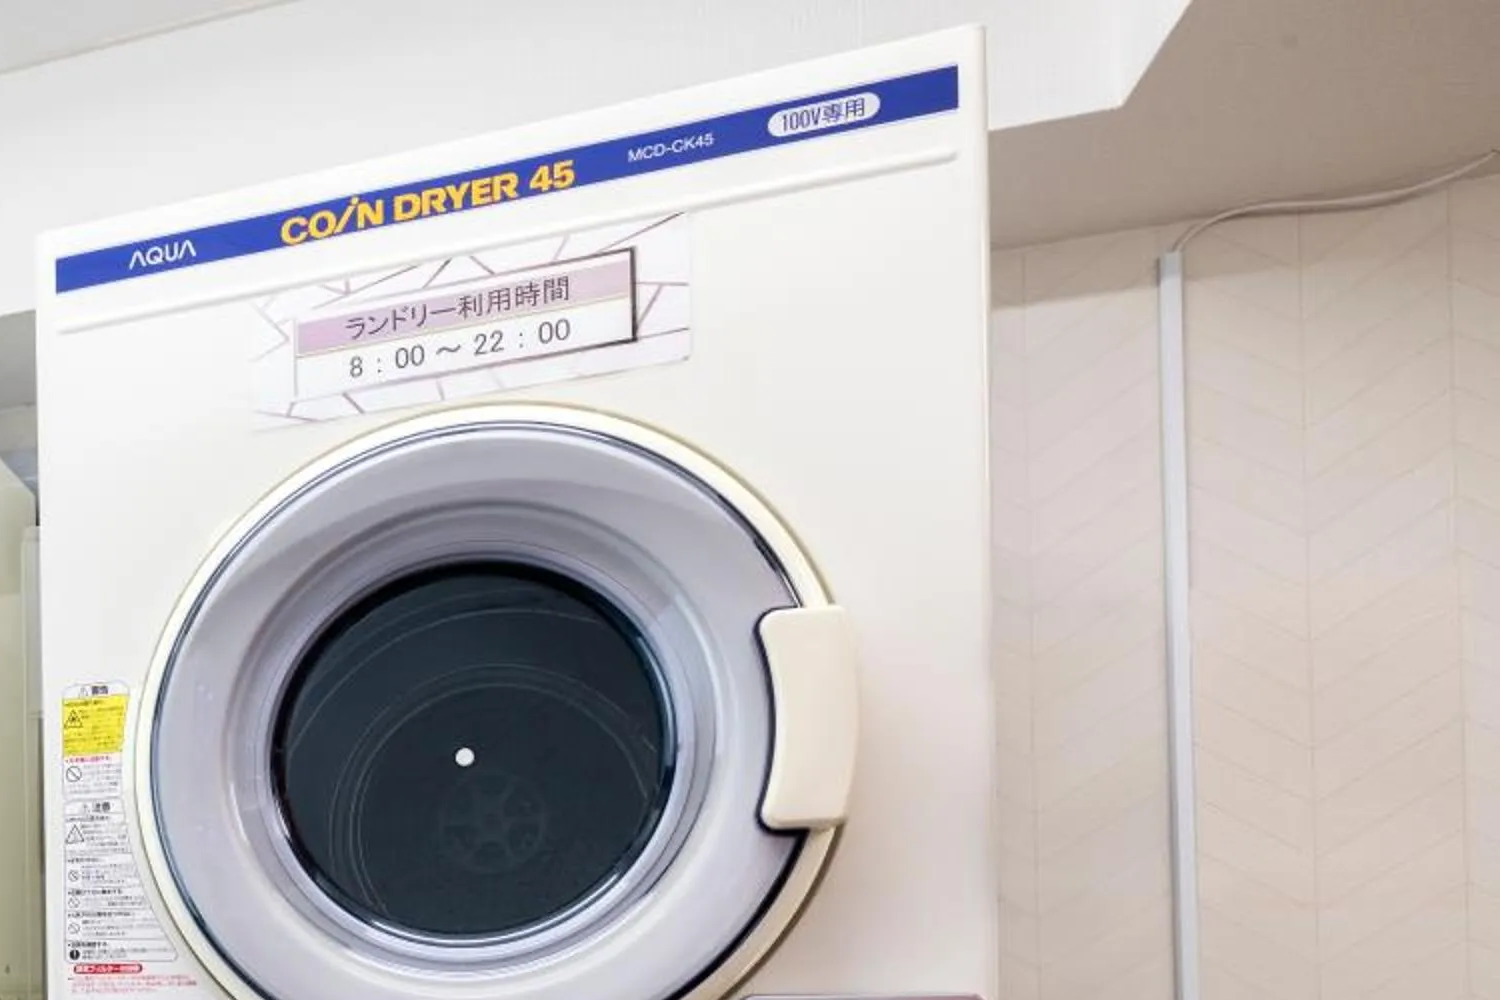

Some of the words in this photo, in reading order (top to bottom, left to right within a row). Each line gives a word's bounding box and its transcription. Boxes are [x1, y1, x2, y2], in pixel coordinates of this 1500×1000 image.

[779, 97, 868, 134] 100V専用
[627, 131, 715, 164] MCD-CK45
[393, 173, 519, 226] DRYER
[528, 159, 577, 195] 45
[128, 238, 196, 270] AQUA
[344, 276, 571, 338] ランドリー利用時間
